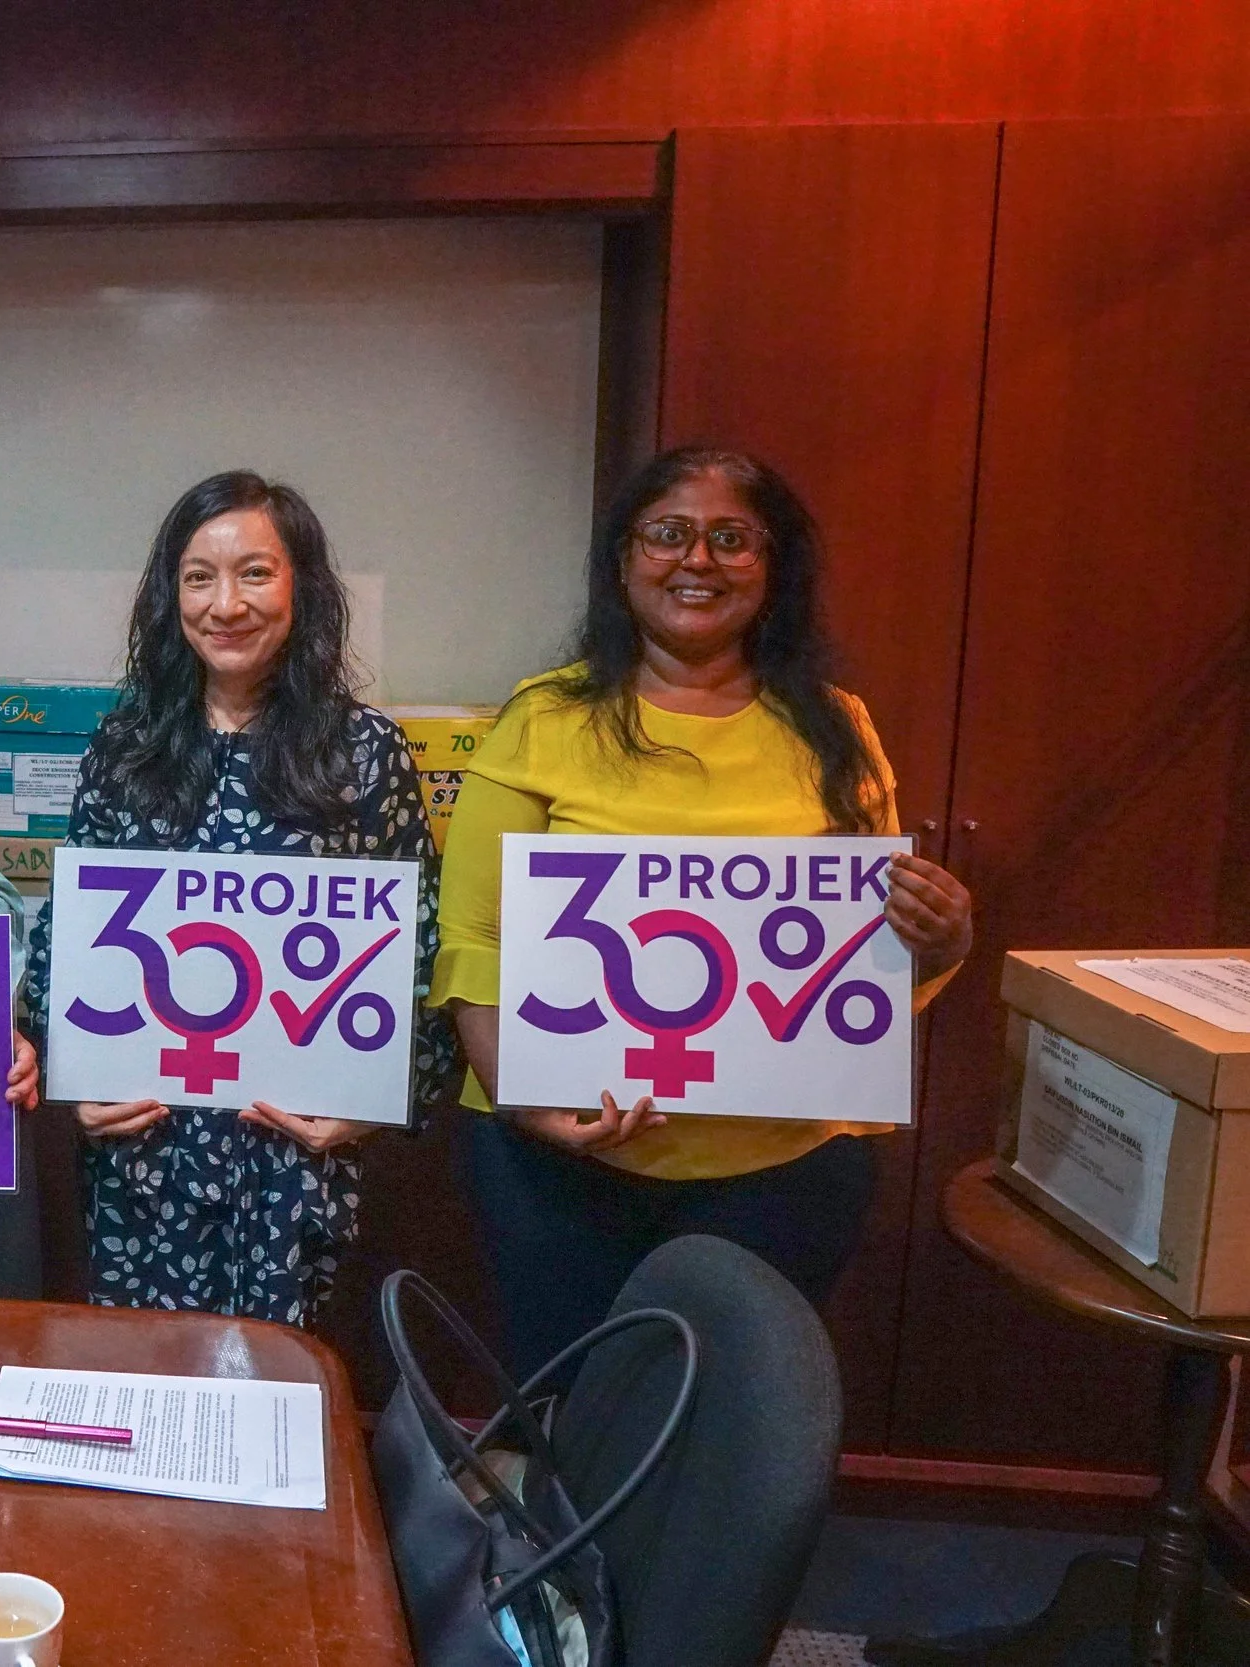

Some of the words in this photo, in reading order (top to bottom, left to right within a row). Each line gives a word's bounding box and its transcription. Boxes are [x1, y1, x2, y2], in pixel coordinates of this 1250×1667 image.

[2, 695, 46, 724] One
[451, 735, 476, 752] 70
[638, 853, 891, 902] PROJEK
[177, 868, 402, 922] PROJEK
[1107, 1121, 1120, 1138] BIN
[1119, 1129, 1143, 1154] ISMAIL
